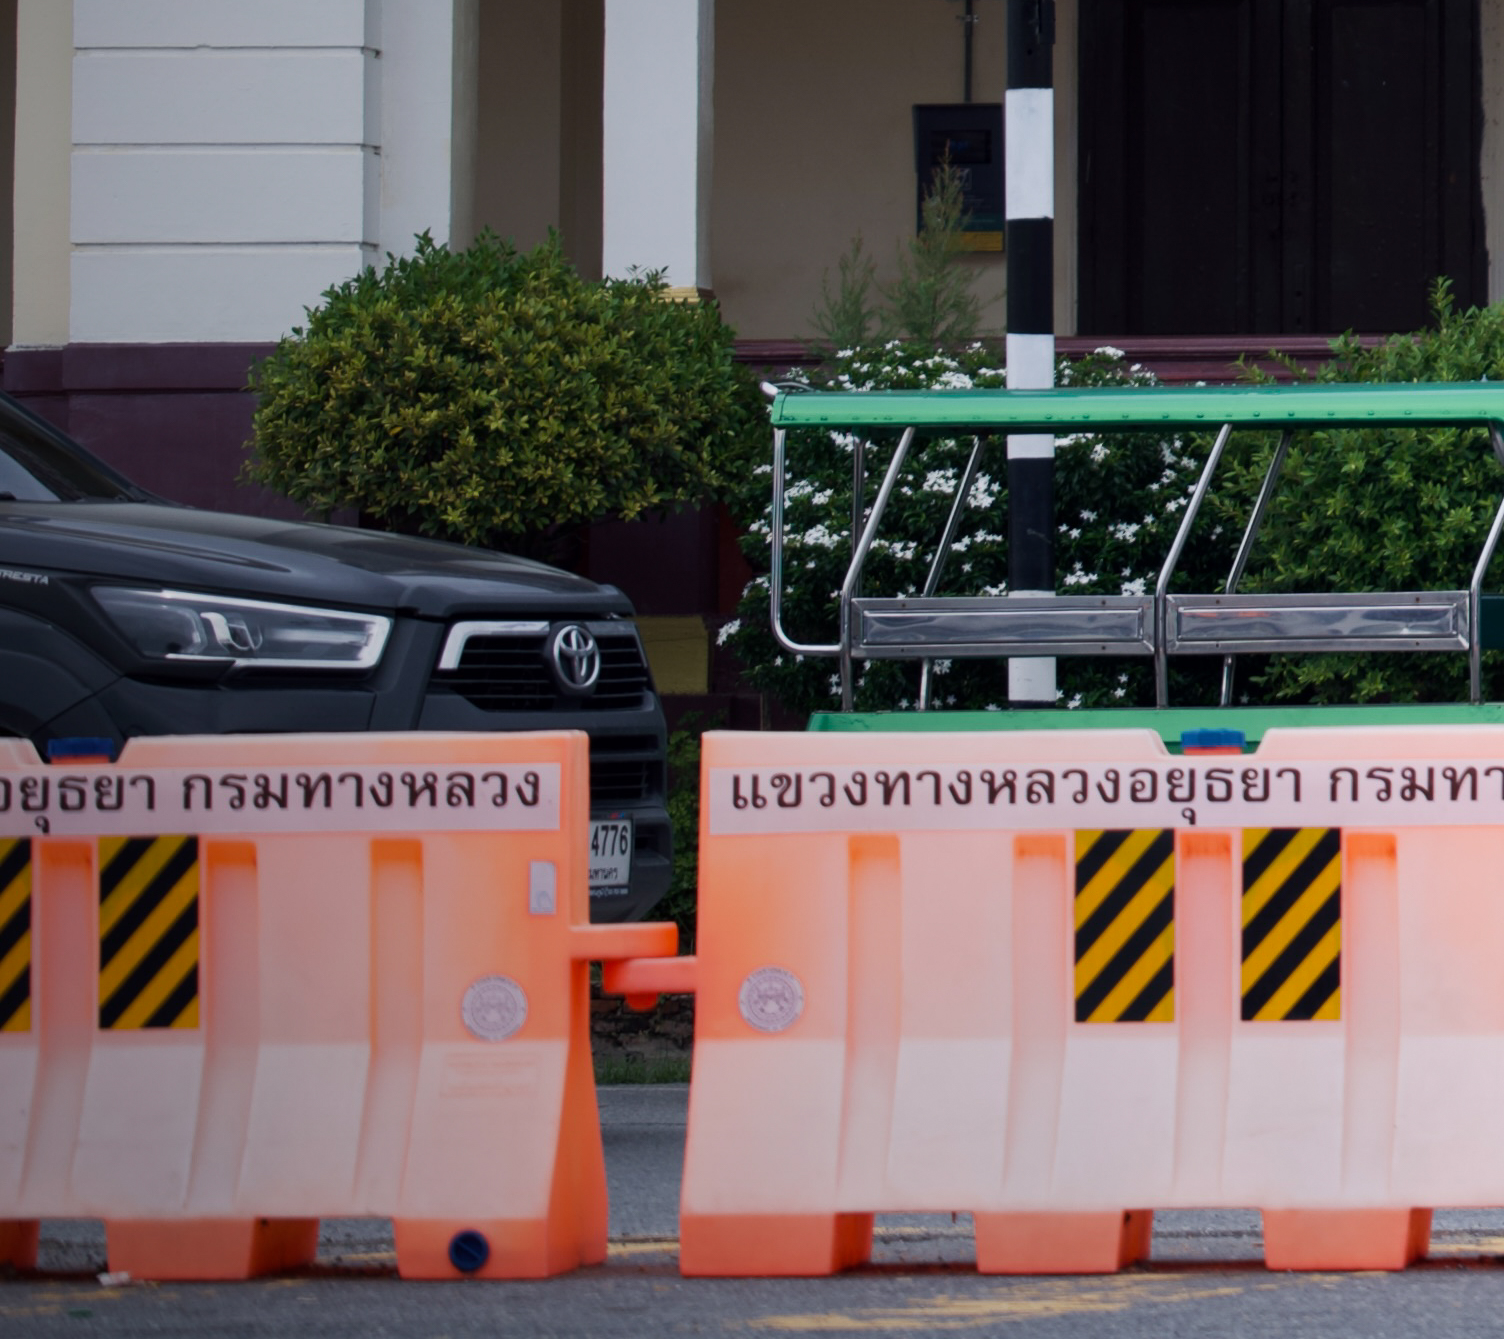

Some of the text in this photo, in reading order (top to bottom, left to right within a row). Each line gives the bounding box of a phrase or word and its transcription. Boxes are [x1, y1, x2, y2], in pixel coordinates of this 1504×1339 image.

[182, 768, 541, 811] กรมทางหลวง
[730, 764, 1303, 825] แขวงทางหลวงอยุธยา
[591, 824, 628, 856] 4776
